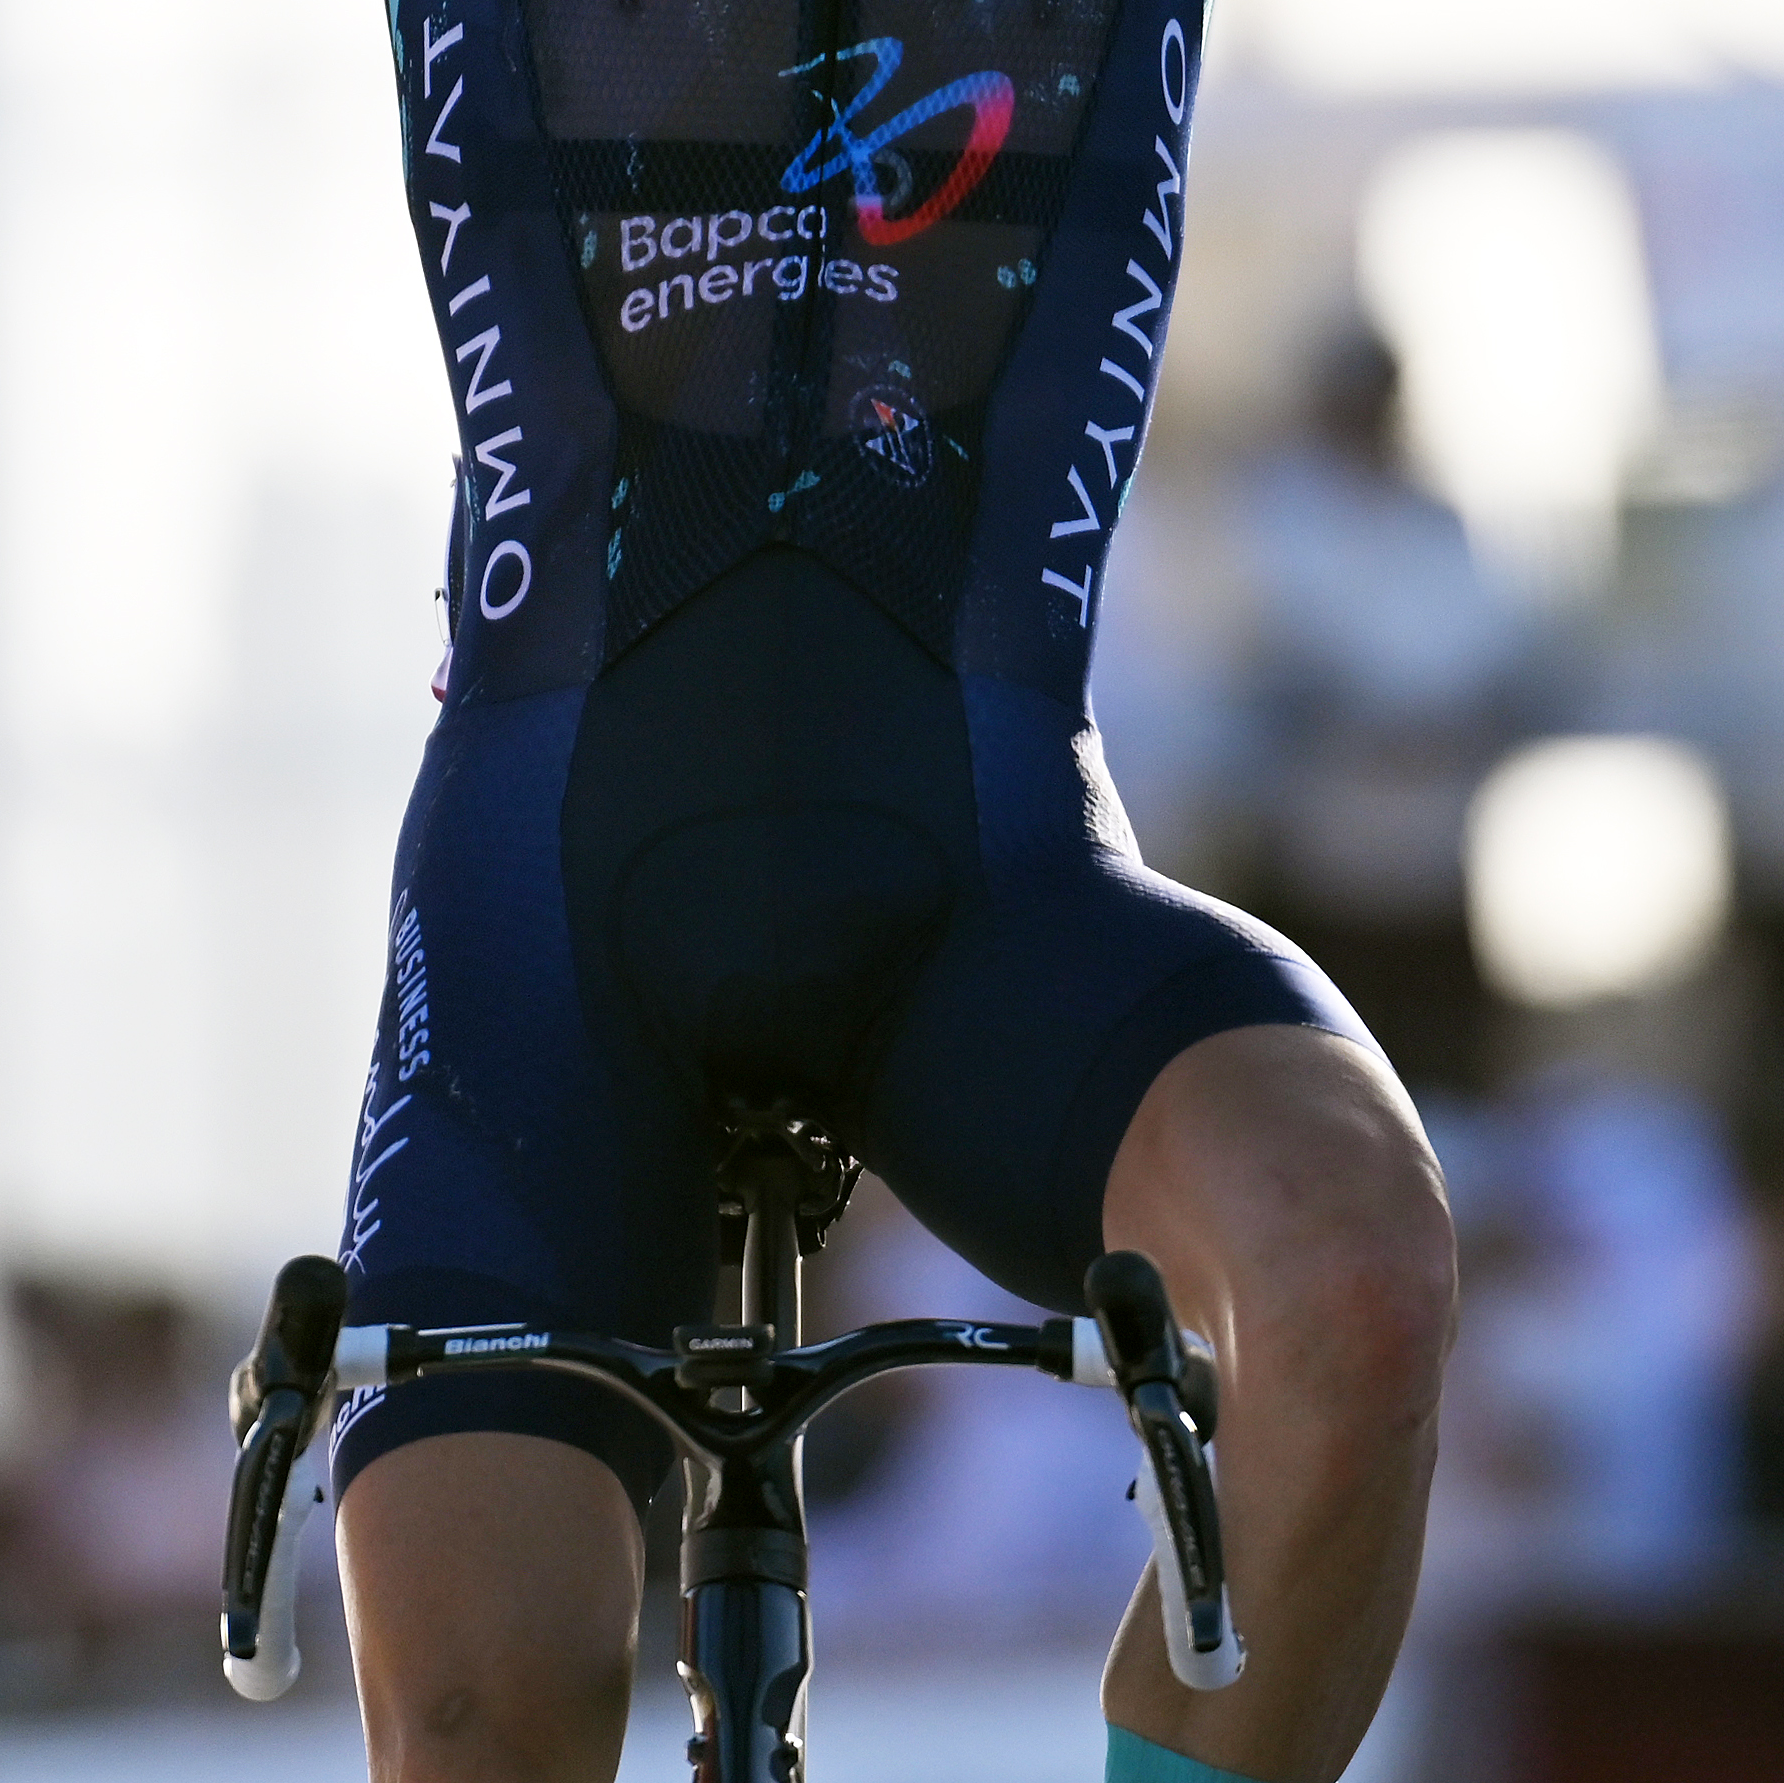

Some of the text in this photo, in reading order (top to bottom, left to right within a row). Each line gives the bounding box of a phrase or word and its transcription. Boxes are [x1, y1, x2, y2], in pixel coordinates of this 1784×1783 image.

[620, 205, 827, 272] Bapco
[424, 16, 532, 620] OMNIYAT
[620, 245, 900, 333] energies
[1041, 18, 1187, 628] OMNIYAT
[395, 906, 431, 1083] BUSINESS
[444, 1331, 551, 1355] Bianchi
[688, 1337, 754, 1351] GARMIN
